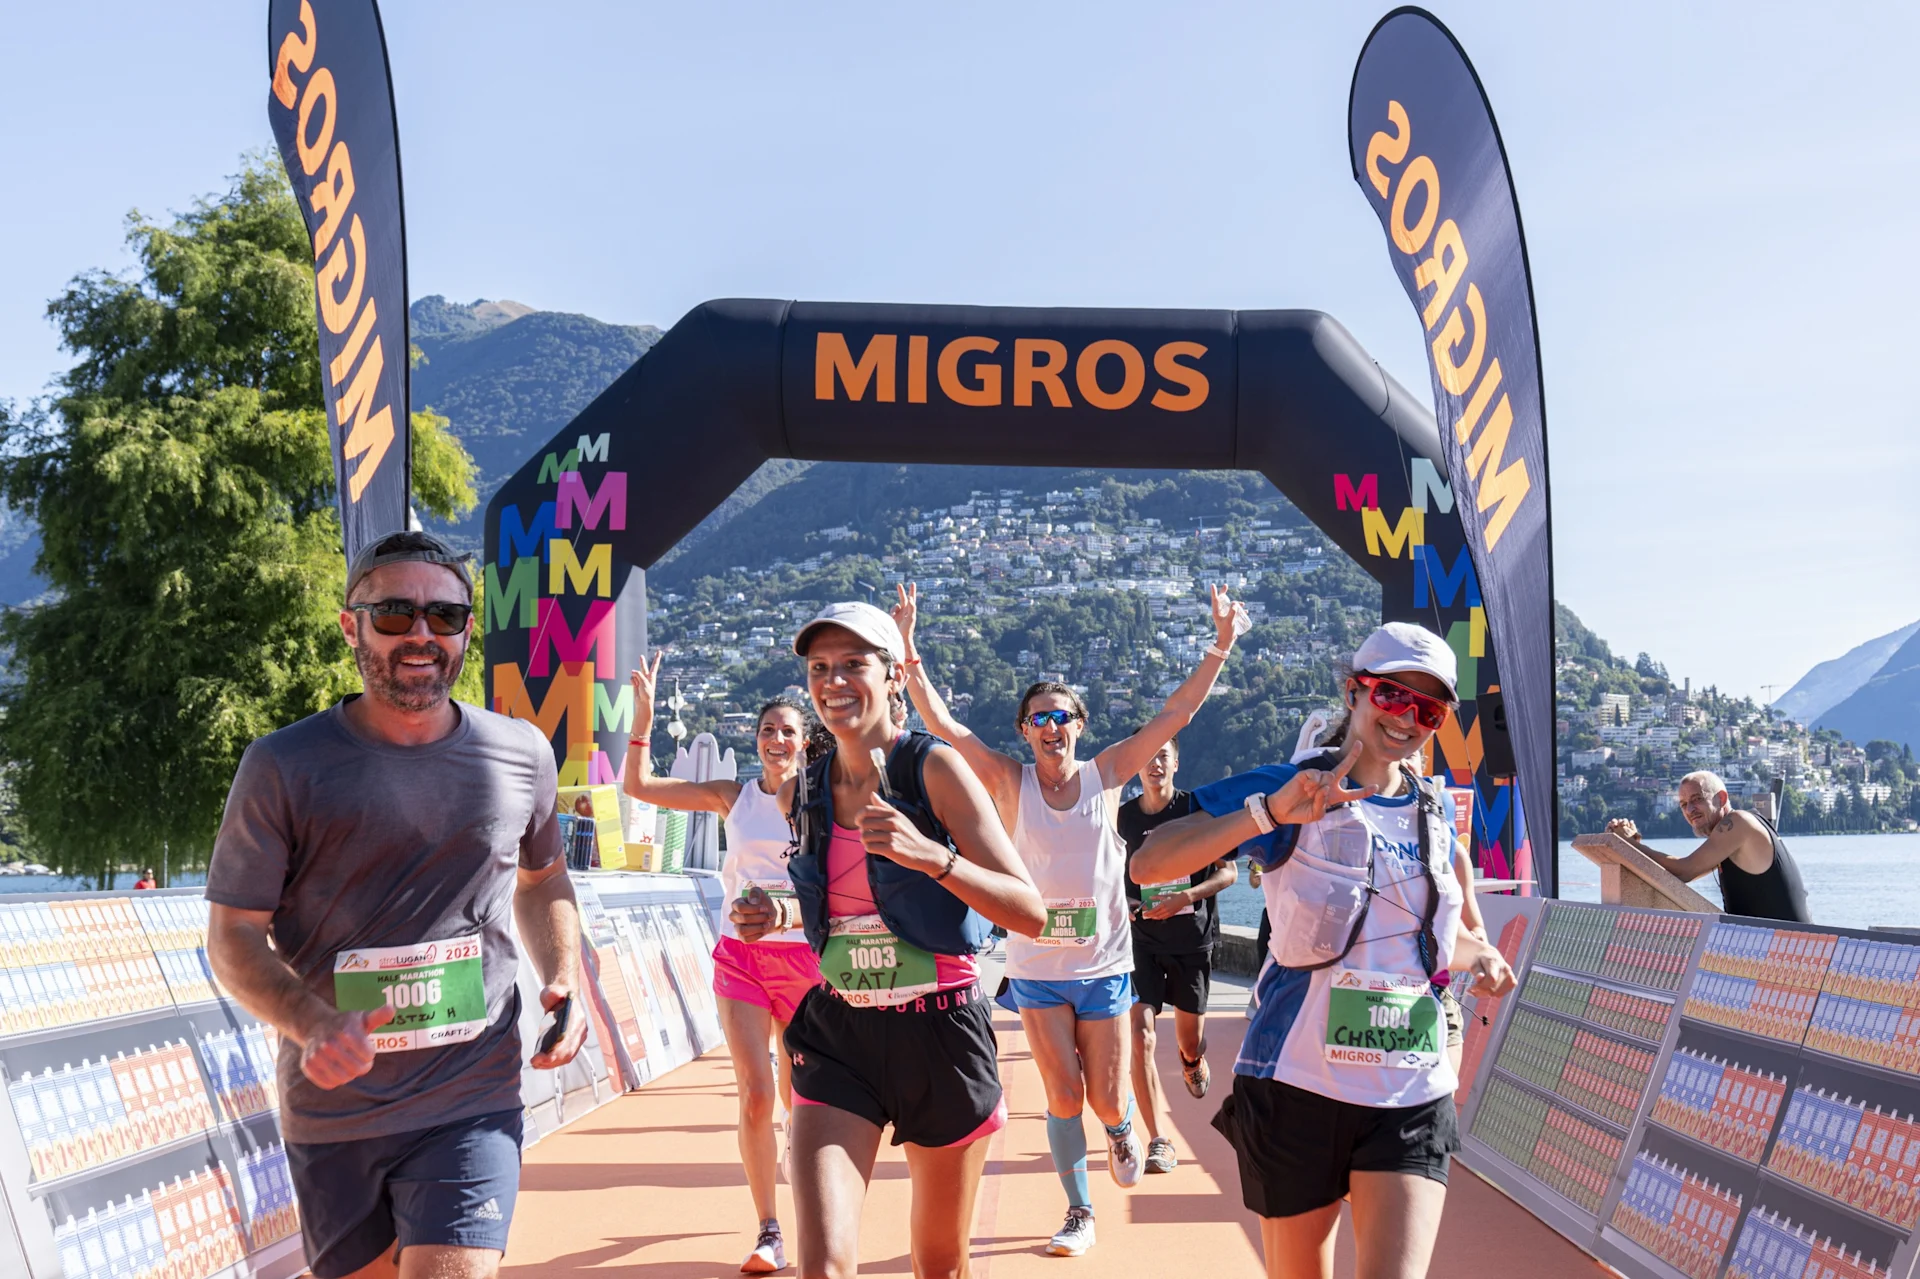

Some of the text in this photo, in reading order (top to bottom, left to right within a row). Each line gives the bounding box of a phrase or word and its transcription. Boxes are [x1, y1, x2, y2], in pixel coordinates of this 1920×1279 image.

[815, 332, 1210, 412] MIGROS
[577, 432, 611, 462] M
[537, 448, 580, 484] M
[555, 471, 628, 531] M
[1334, 473, 1378, 512] M
[500, 501, 563, 568] M
[1361, 507, 1425, 560] M
[549, 538, 612, 598] M
[485, 556, 540, 635] M
[529, 598, 616, 680] M
[1079, 900, 1096, 908] 2023
[1051, 927, 1077, 937] ANDREA
[1054, 915, 1072, 928] 101
[446, 945, 479, 960] 2023
[848, 945, 897, 970] 1003
[382, 979, 442, 1009] 1006
[447, 1007, 456, 1018] H
[1368, 1005, 1411, 1030] 1004
[1331, 1049, 1382, 1063] MIGROS
[474, 1209, 503, 1221] adidas
